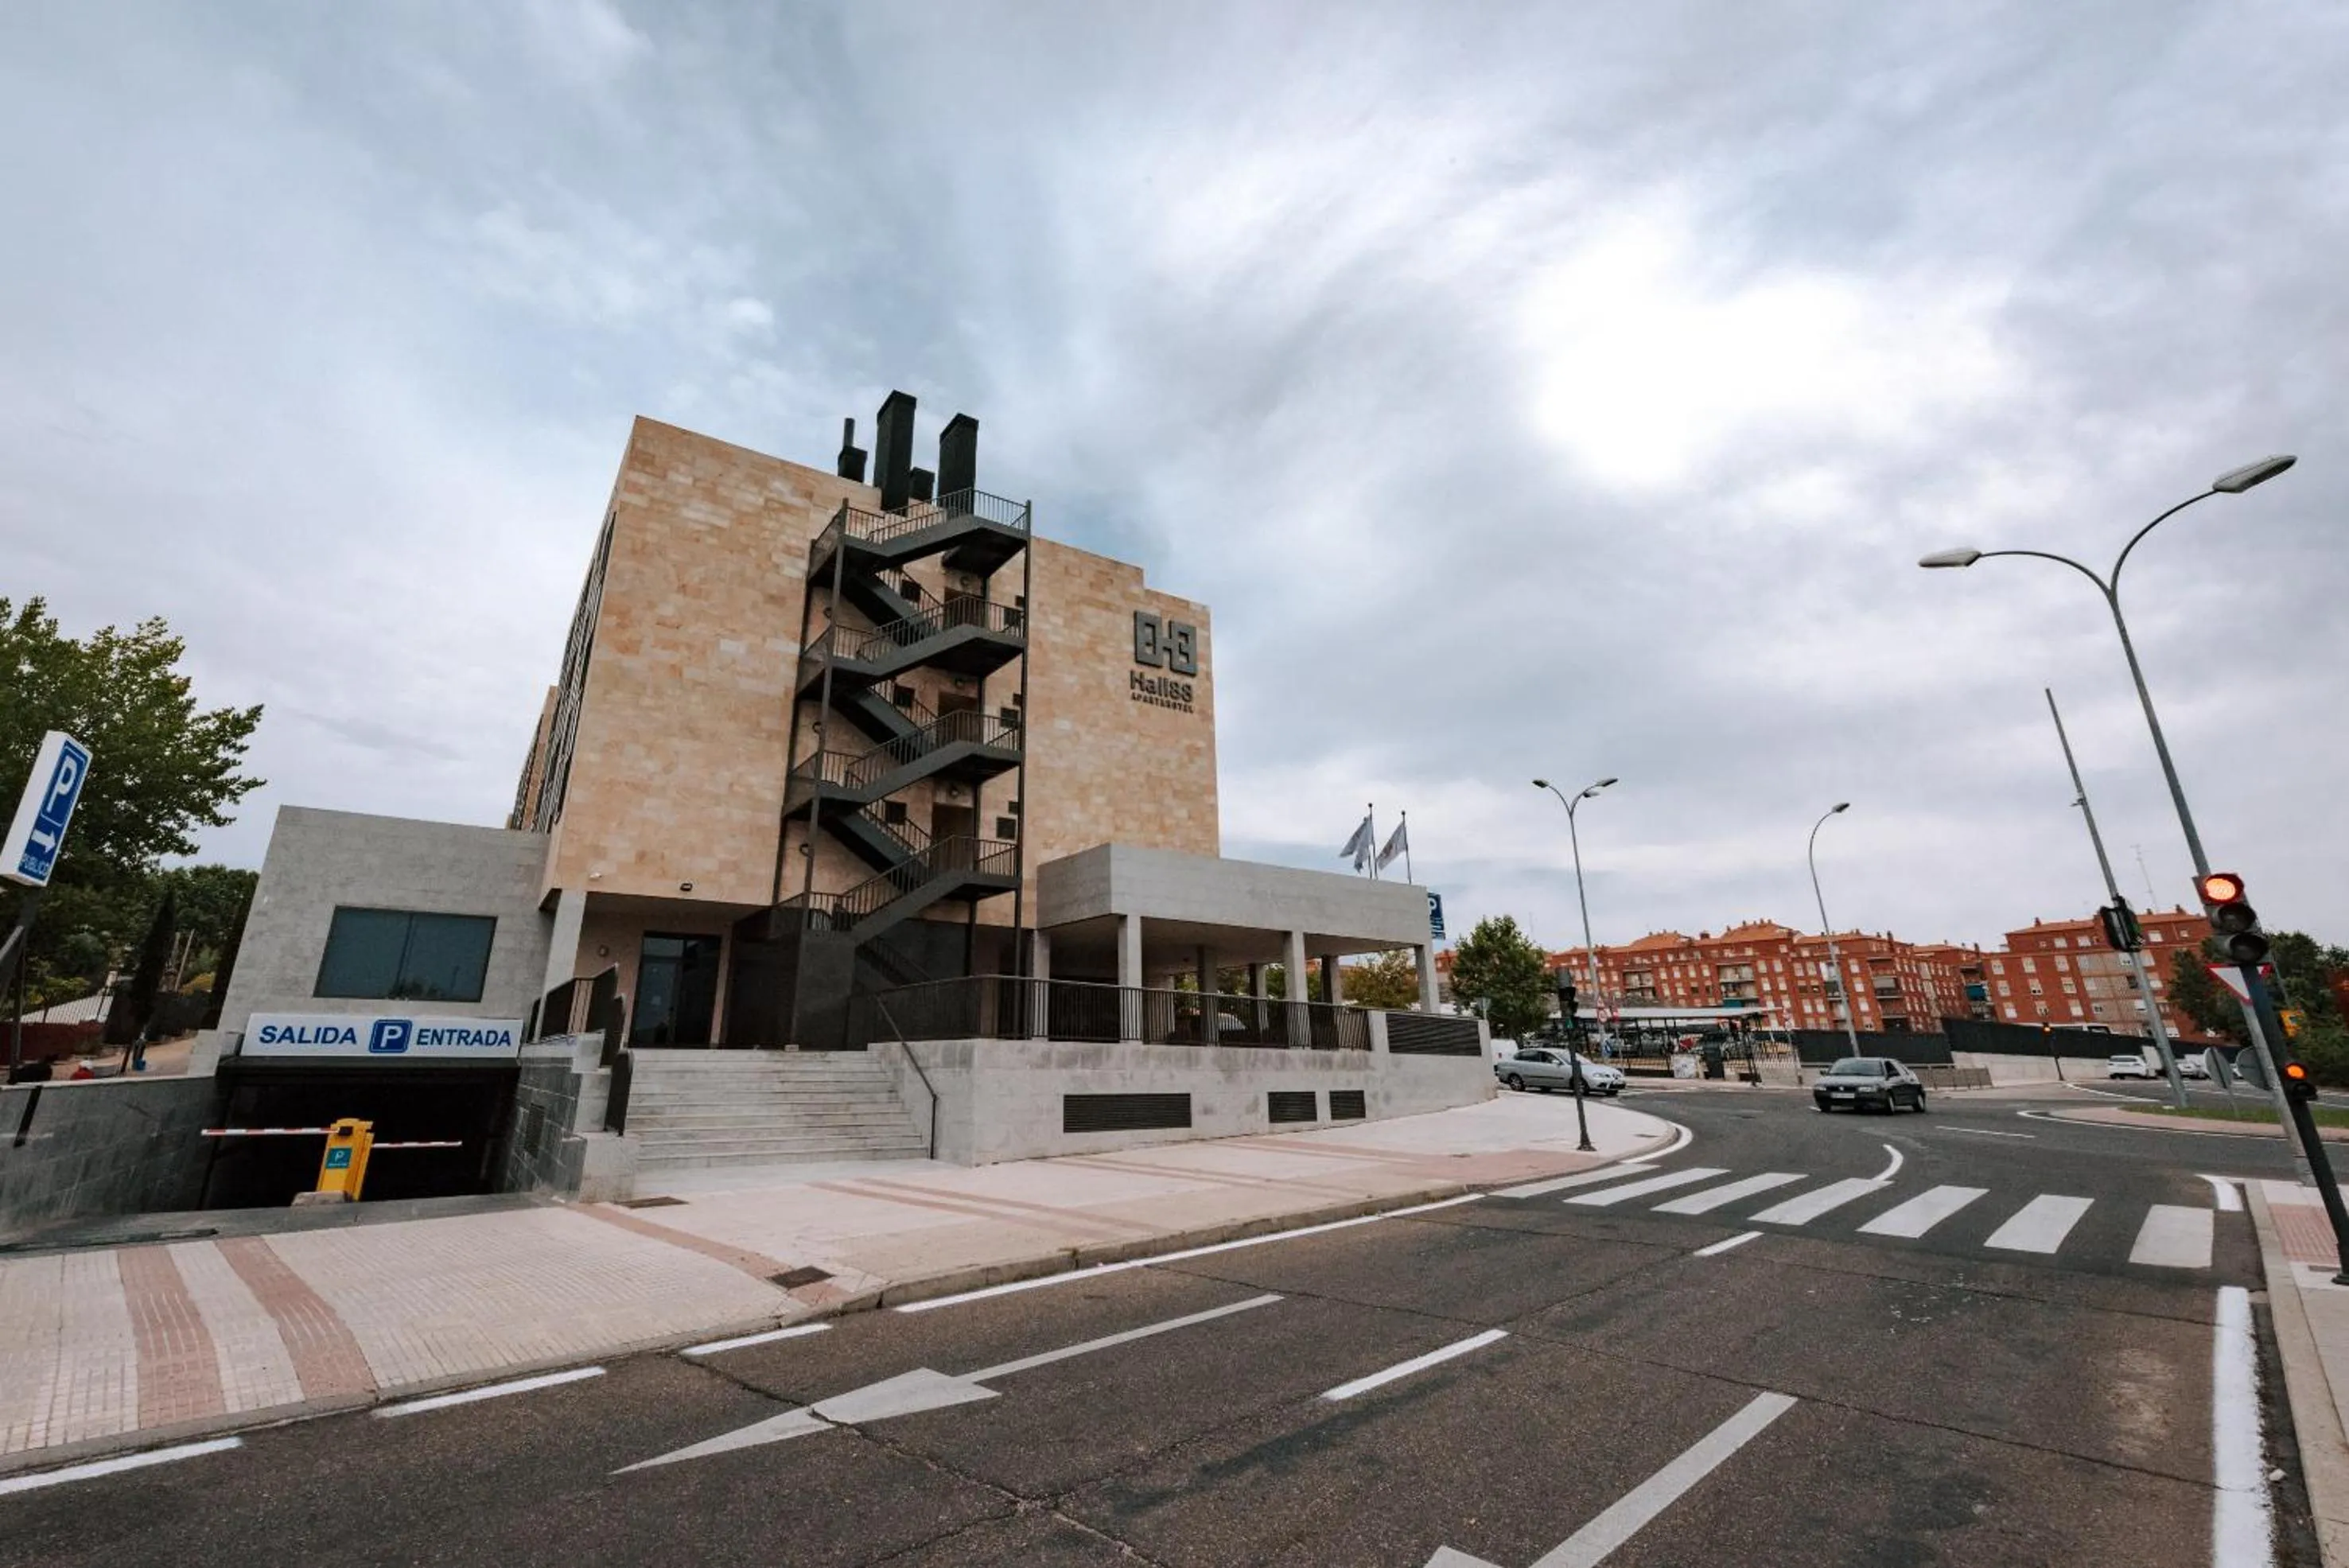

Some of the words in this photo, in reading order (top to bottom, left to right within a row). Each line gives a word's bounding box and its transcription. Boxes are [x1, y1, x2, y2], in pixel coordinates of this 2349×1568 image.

[45, 756, 78, 813] P
[259, 1025, 357, 1044] SALIDA
[379, 1025, 403, 1048] P
[416, 1028, 511, 1046] ENTRADA
